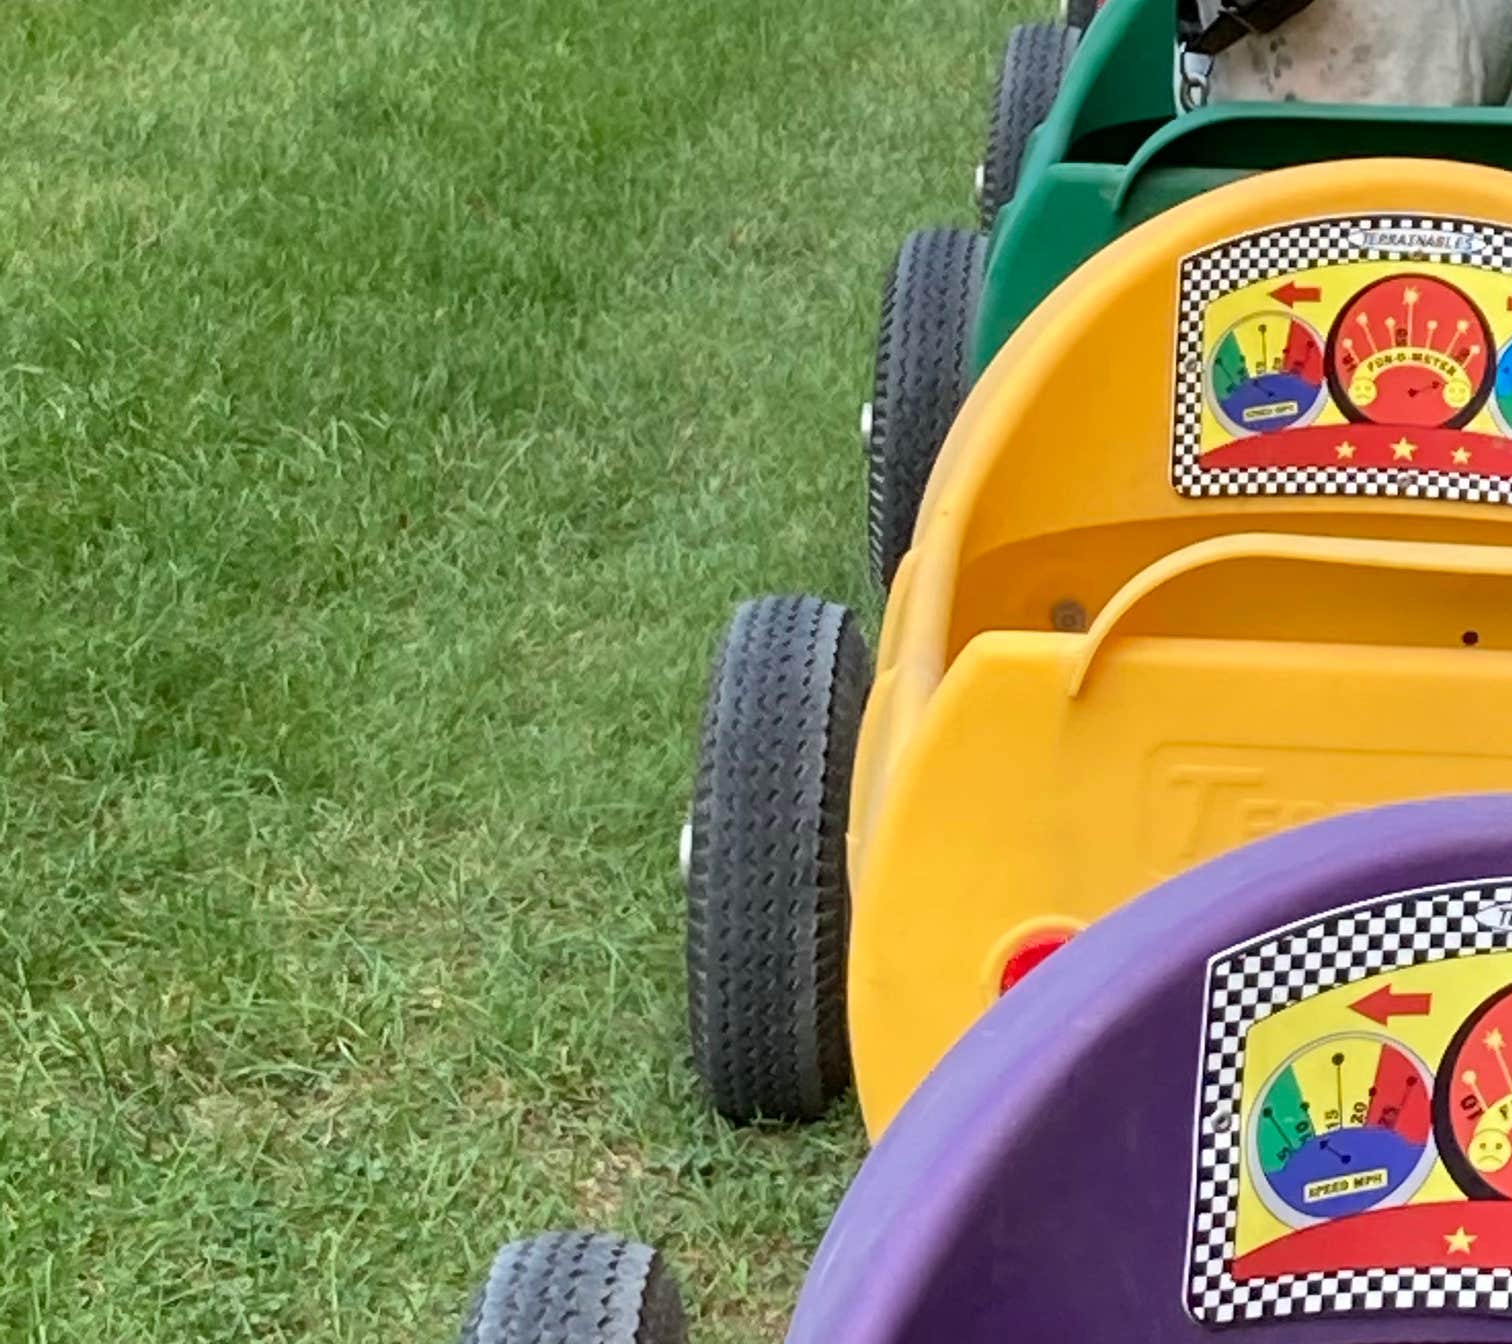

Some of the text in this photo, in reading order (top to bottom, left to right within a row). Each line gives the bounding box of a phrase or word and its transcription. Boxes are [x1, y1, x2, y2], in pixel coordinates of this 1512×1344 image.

[1350, 1102, 1367, 1124] 20
[1308, 1173, 1383, 1198] SPEED MPH
